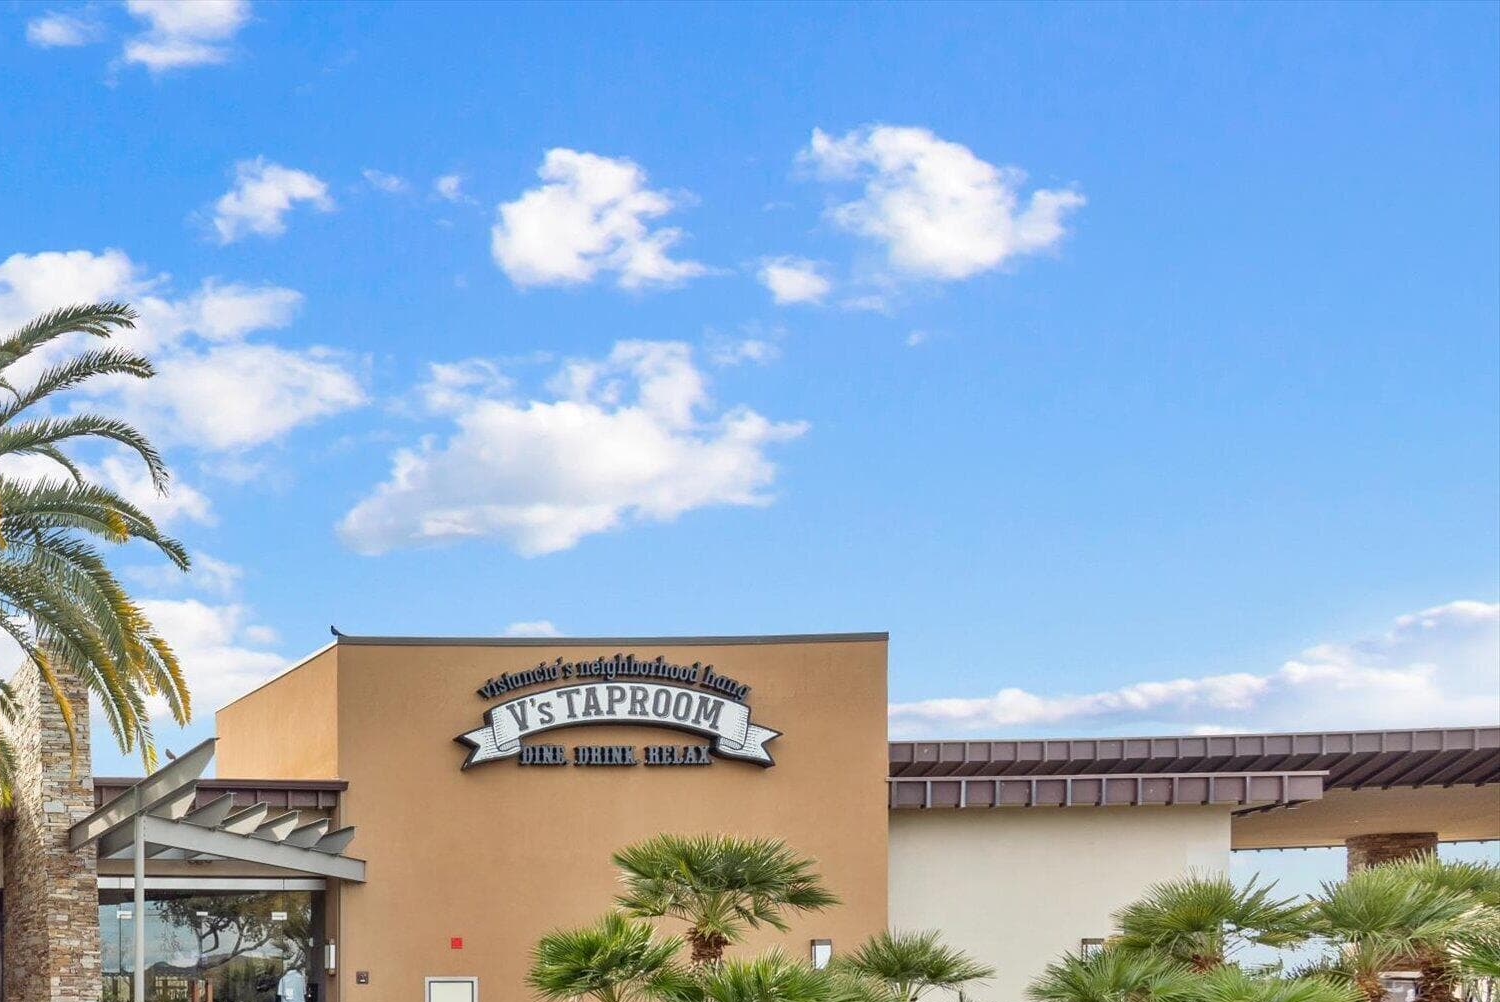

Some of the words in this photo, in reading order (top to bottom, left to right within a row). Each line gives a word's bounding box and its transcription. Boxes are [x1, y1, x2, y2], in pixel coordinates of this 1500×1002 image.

[574, 653, 701, 685] neighborhood
[702, 664, 752, 701] hang
[506, 698, 555, 732] V's
[556, 684, 725, 731] TAPROOM
